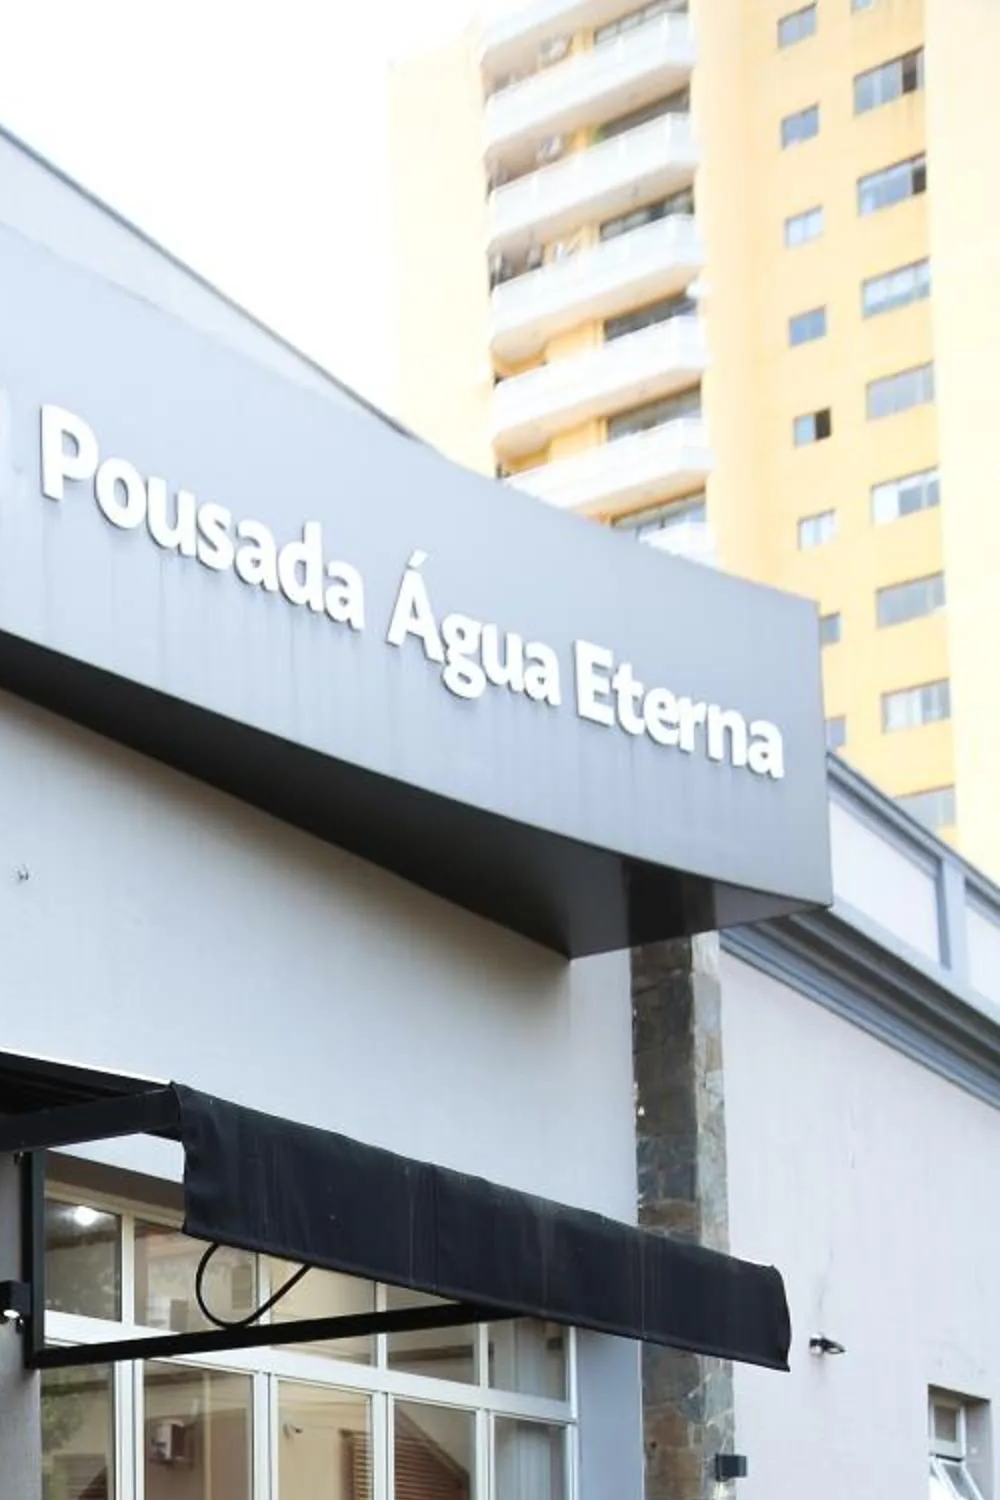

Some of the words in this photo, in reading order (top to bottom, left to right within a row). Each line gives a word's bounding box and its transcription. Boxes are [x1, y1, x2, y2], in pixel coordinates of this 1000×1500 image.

[40, 404, 365, 630] Pousada
[387, 550, 562, 707] Água
[573, 639, 784, 780] Eterna
